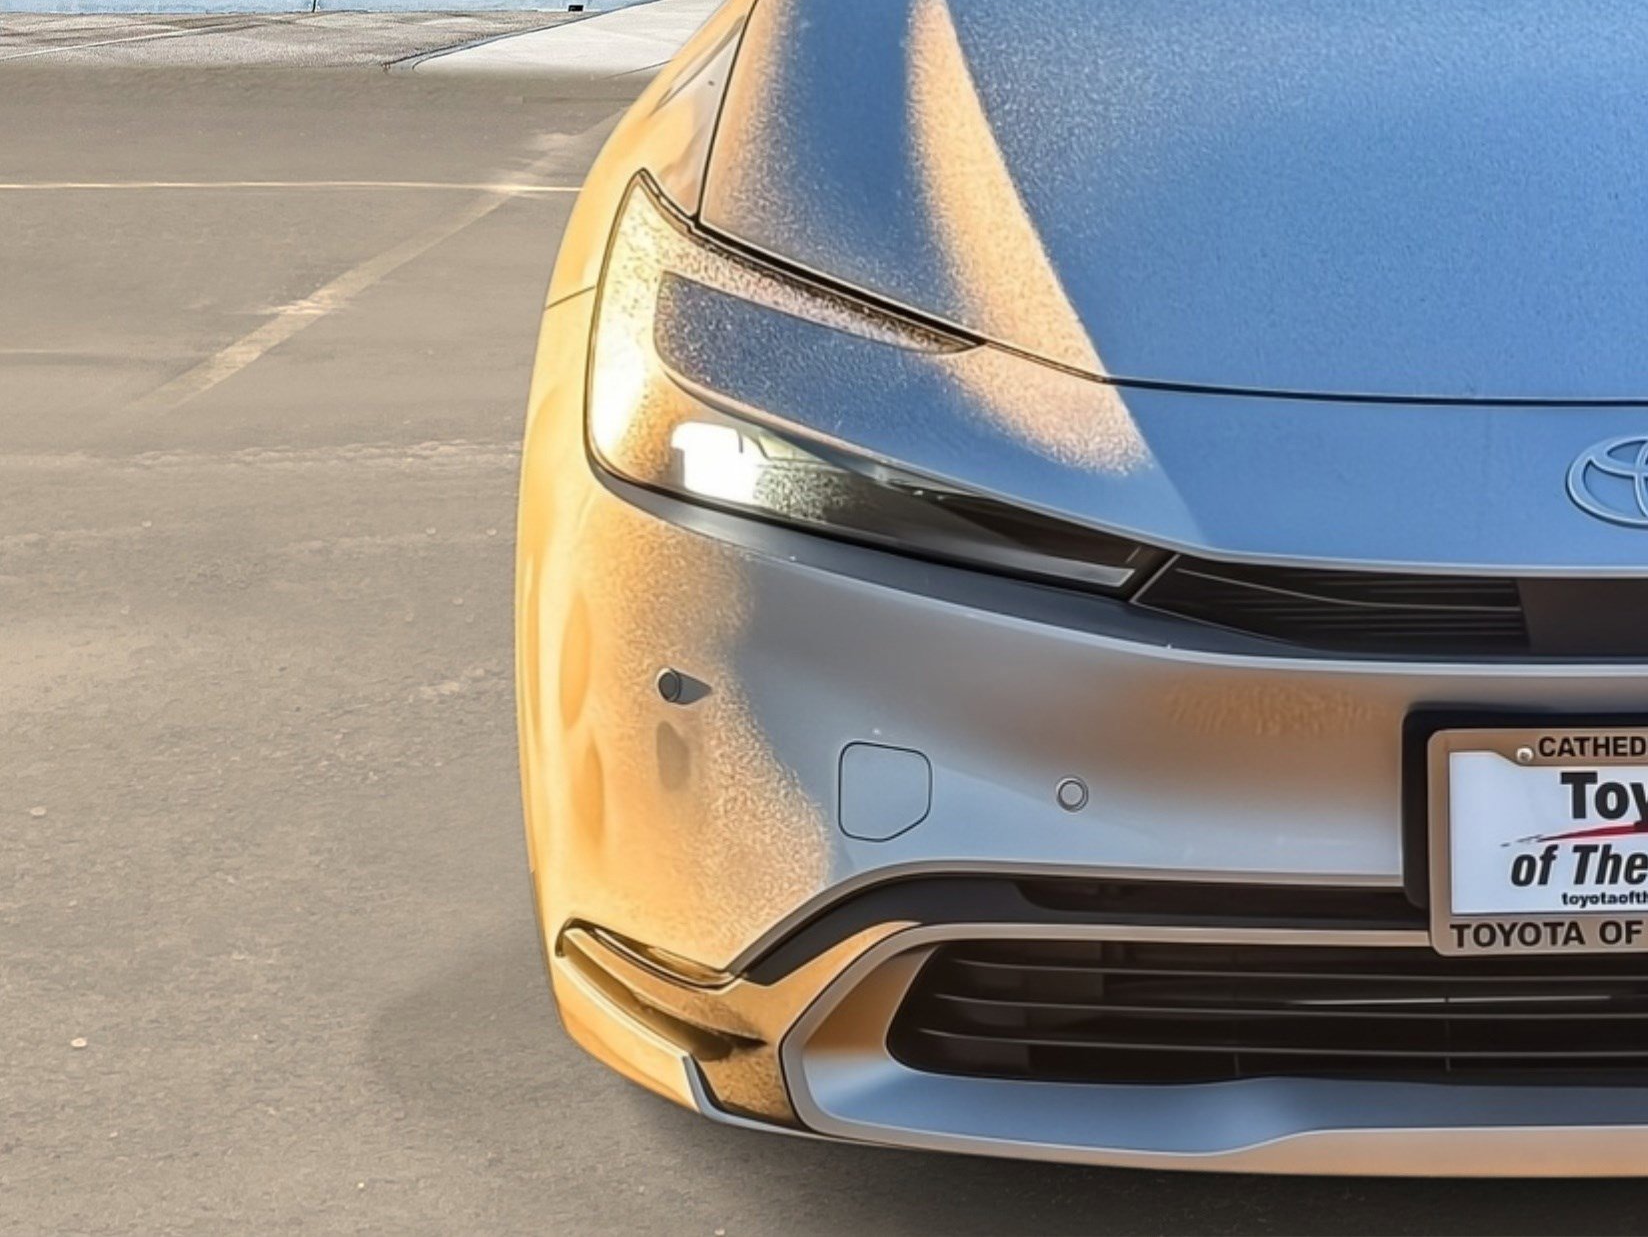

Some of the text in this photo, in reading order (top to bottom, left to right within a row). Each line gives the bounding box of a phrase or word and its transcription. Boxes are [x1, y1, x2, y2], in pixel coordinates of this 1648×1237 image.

[1511, 845, 1558, 887] of
[1449, 920, 1586, 948] TOYOTA
[1599, 920, 1643, 945] OF
